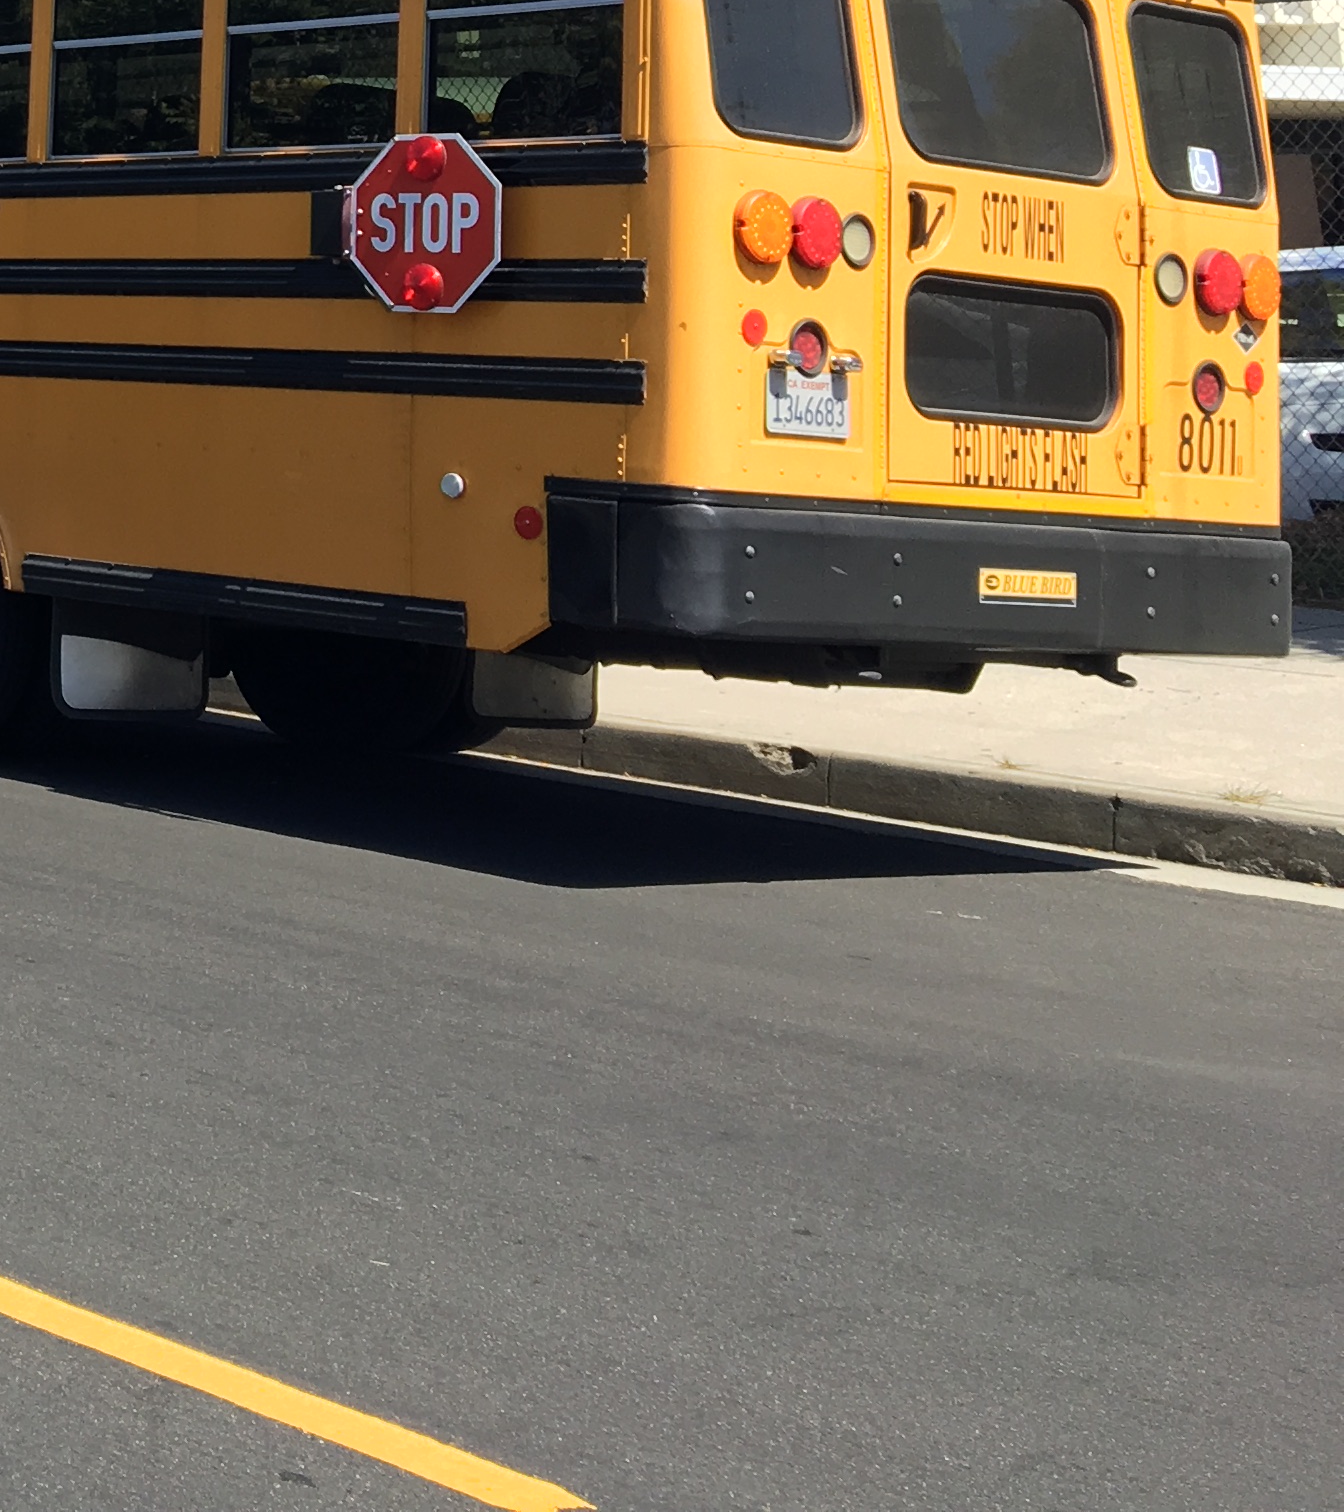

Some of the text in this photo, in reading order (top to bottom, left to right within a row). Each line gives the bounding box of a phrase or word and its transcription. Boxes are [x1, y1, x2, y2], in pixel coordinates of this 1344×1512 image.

[371, 192, 479, 254] STOP
[981, 190, 1064, 264] STOP WHEN
[772, 393, 845, 427] 1346683
[787, 379, 830, 391] CA EXEMPT
[954, 422, 1088, 493] RED LIGHTS FLASH
[1179, 412, 1236, 476] 8011
[1002, 574, 1072, 595] BLUE BIRD
